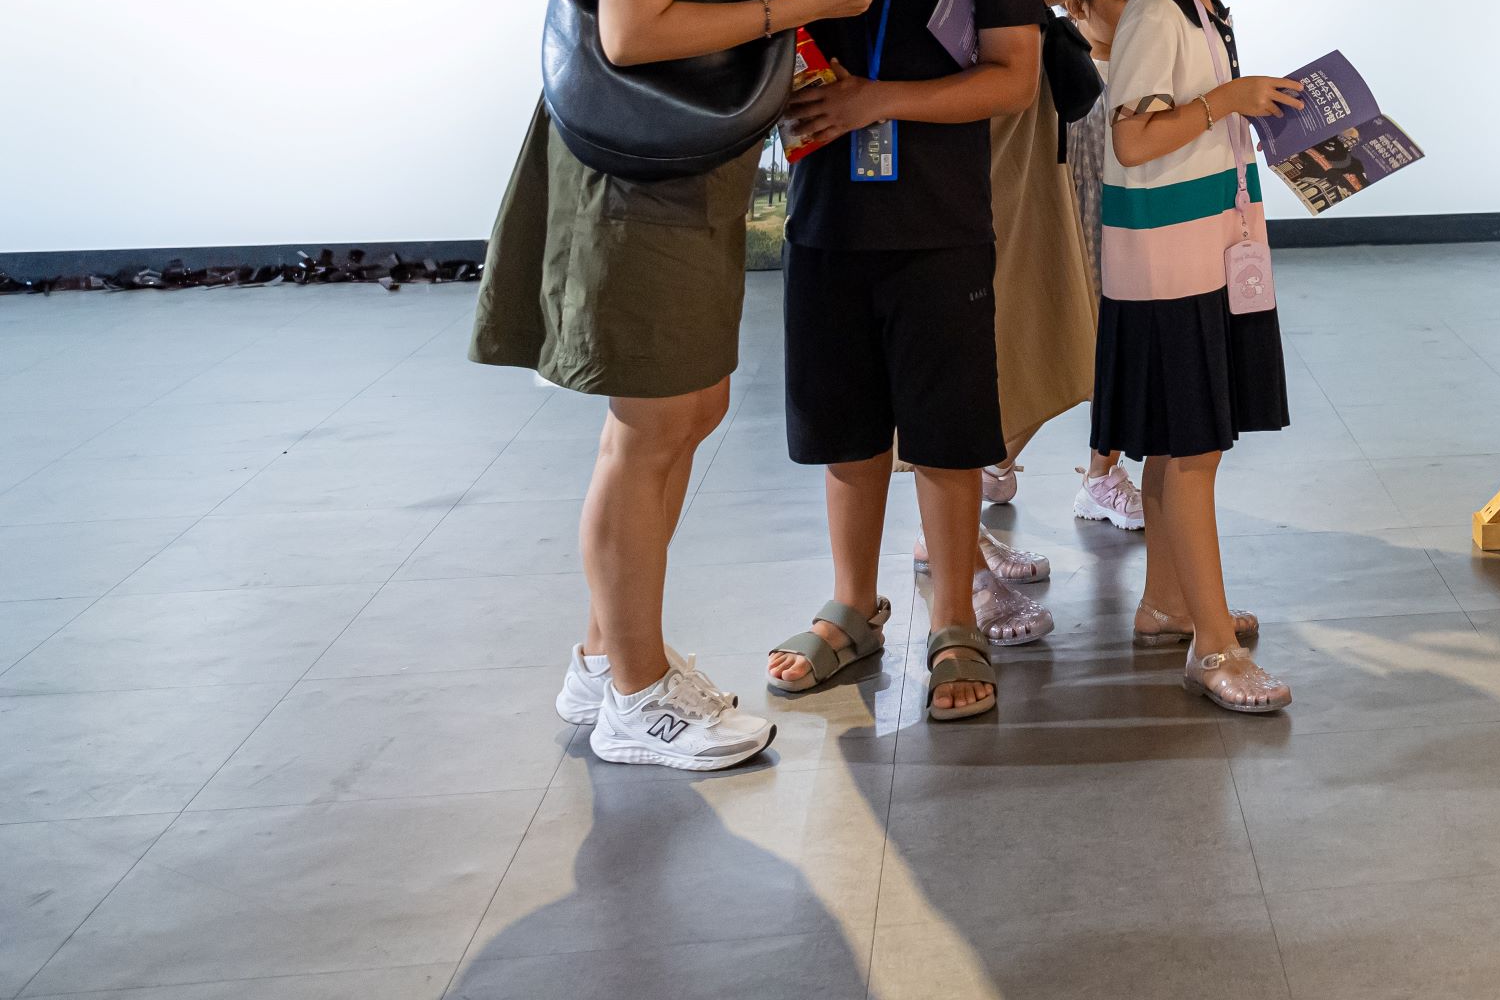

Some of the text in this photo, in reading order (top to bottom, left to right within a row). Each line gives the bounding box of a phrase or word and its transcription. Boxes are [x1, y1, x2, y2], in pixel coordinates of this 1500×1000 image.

[1300, 77, 1327, 106] 문화유산
[1310, 72, 1336, 102] 피란수도
[1332, 101, 1346, 121] 부산
[646, 713, 690, 744] N
